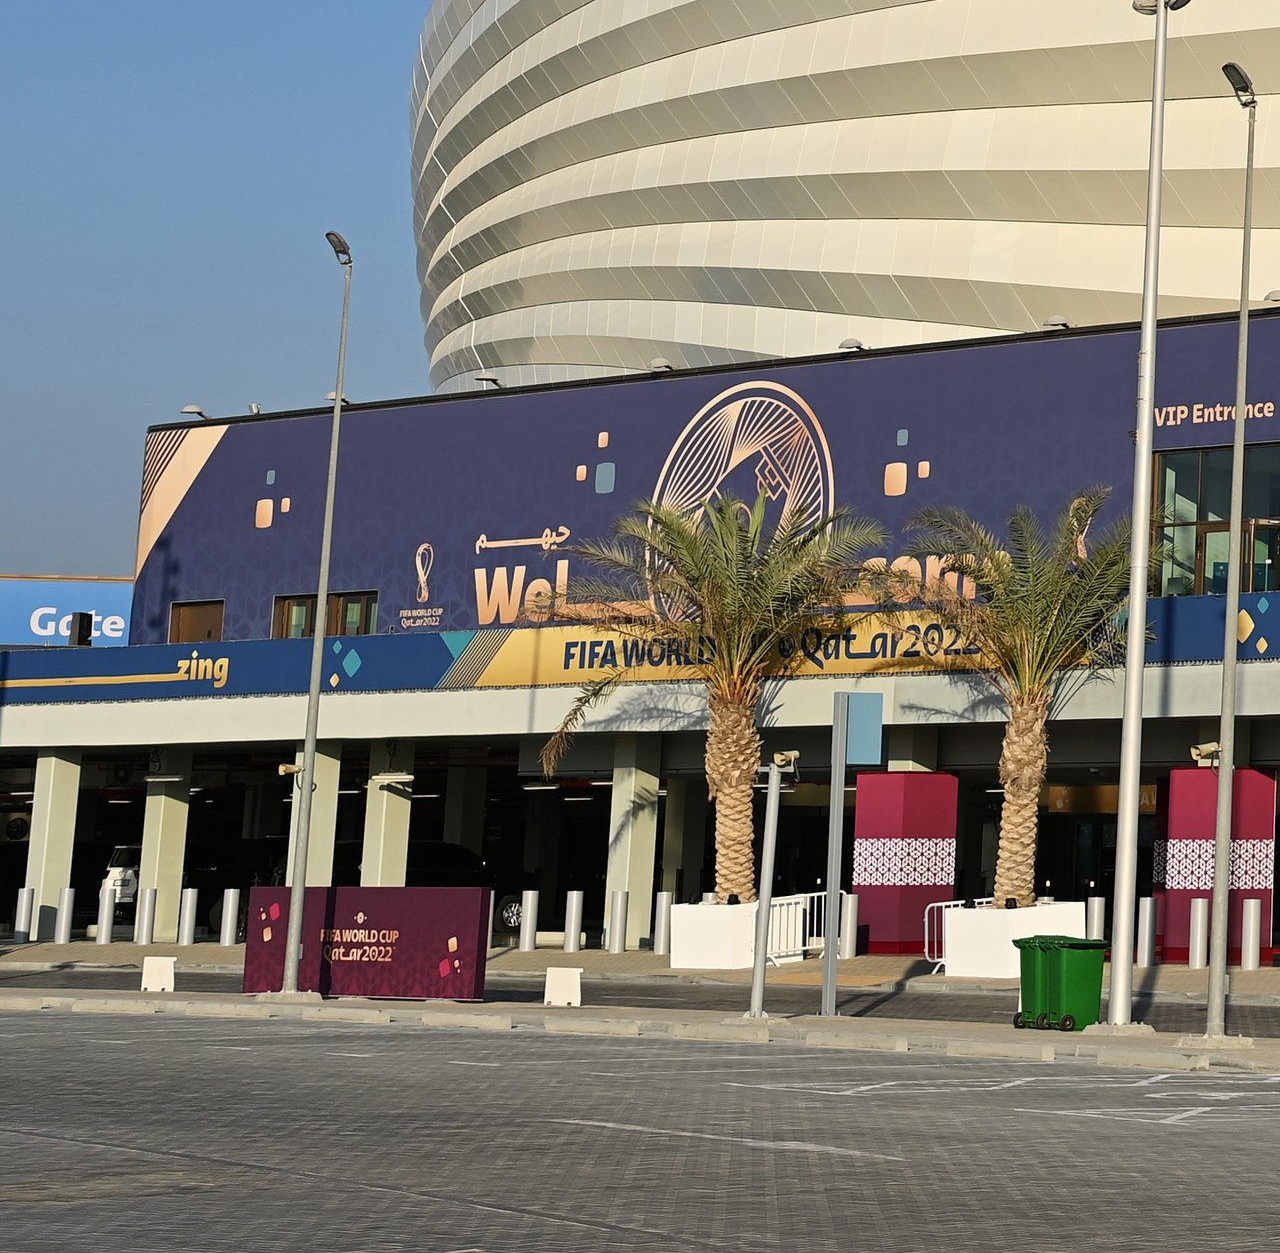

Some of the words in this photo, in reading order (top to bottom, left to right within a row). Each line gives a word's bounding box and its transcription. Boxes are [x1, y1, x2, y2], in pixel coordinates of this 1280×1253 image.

[1154, 404, 1188, 427] VIP
[1192, 401, 1275, 424] Entrance
[412, 608, 432, 616] WORLD
[563, 640, 618, 670] FIFA
[320, 929, 341, 942] FIFA
[342, 929, 378, 943] WORLD
[379, 930, 399, 943] CUP
